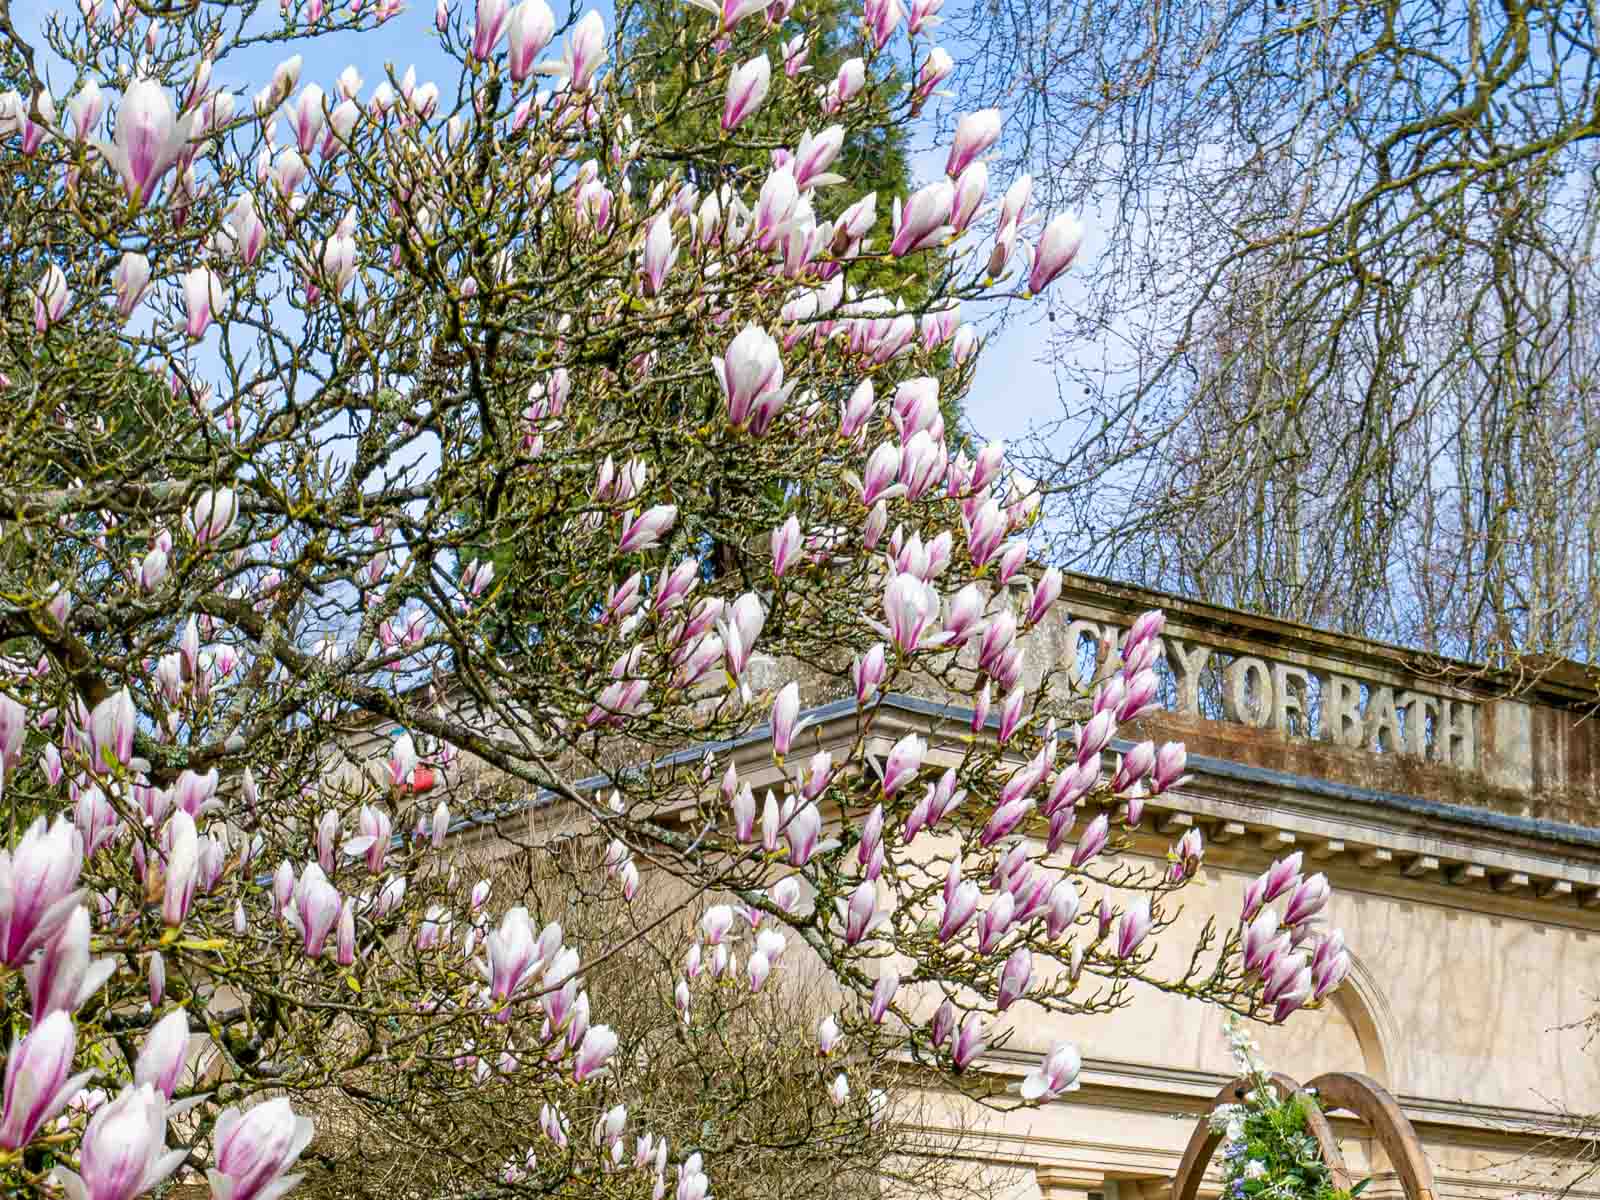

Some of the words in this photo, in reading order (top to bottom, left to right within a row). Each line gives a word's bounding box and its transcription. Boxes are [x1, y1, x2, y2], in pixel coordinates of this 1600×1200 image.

[1069, 619, 1210, 718] CIY
[1233, 656, 1312, 740] OF
[1330, 674, 1478, 768] BATH
